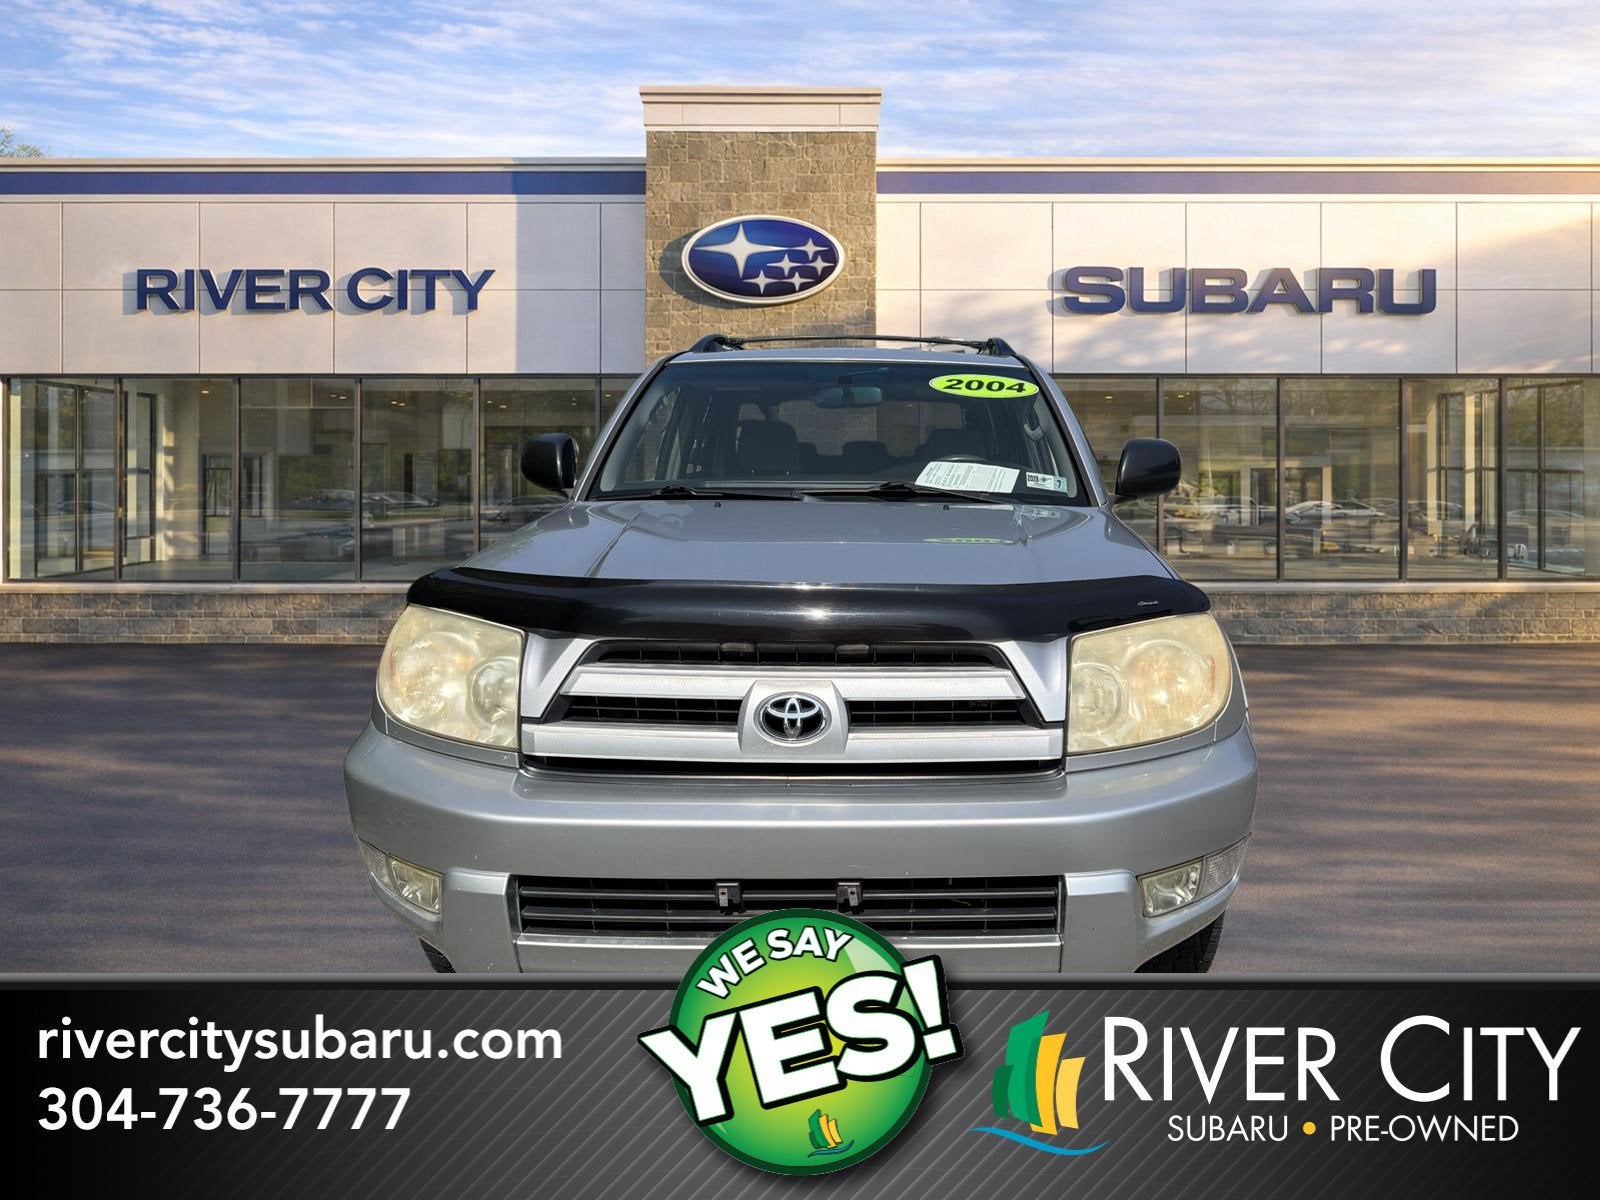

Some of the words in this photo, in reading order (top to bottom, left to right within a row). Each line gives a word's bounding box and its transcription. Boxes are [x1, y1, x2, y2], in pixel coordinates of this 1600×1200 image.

[136, 268, 334, 311] RIVER
[346, 267, 496, 311] CITY
[1063, 266, 1437, 314] SUBARU
[943, 378, 1026, 393] 2004
